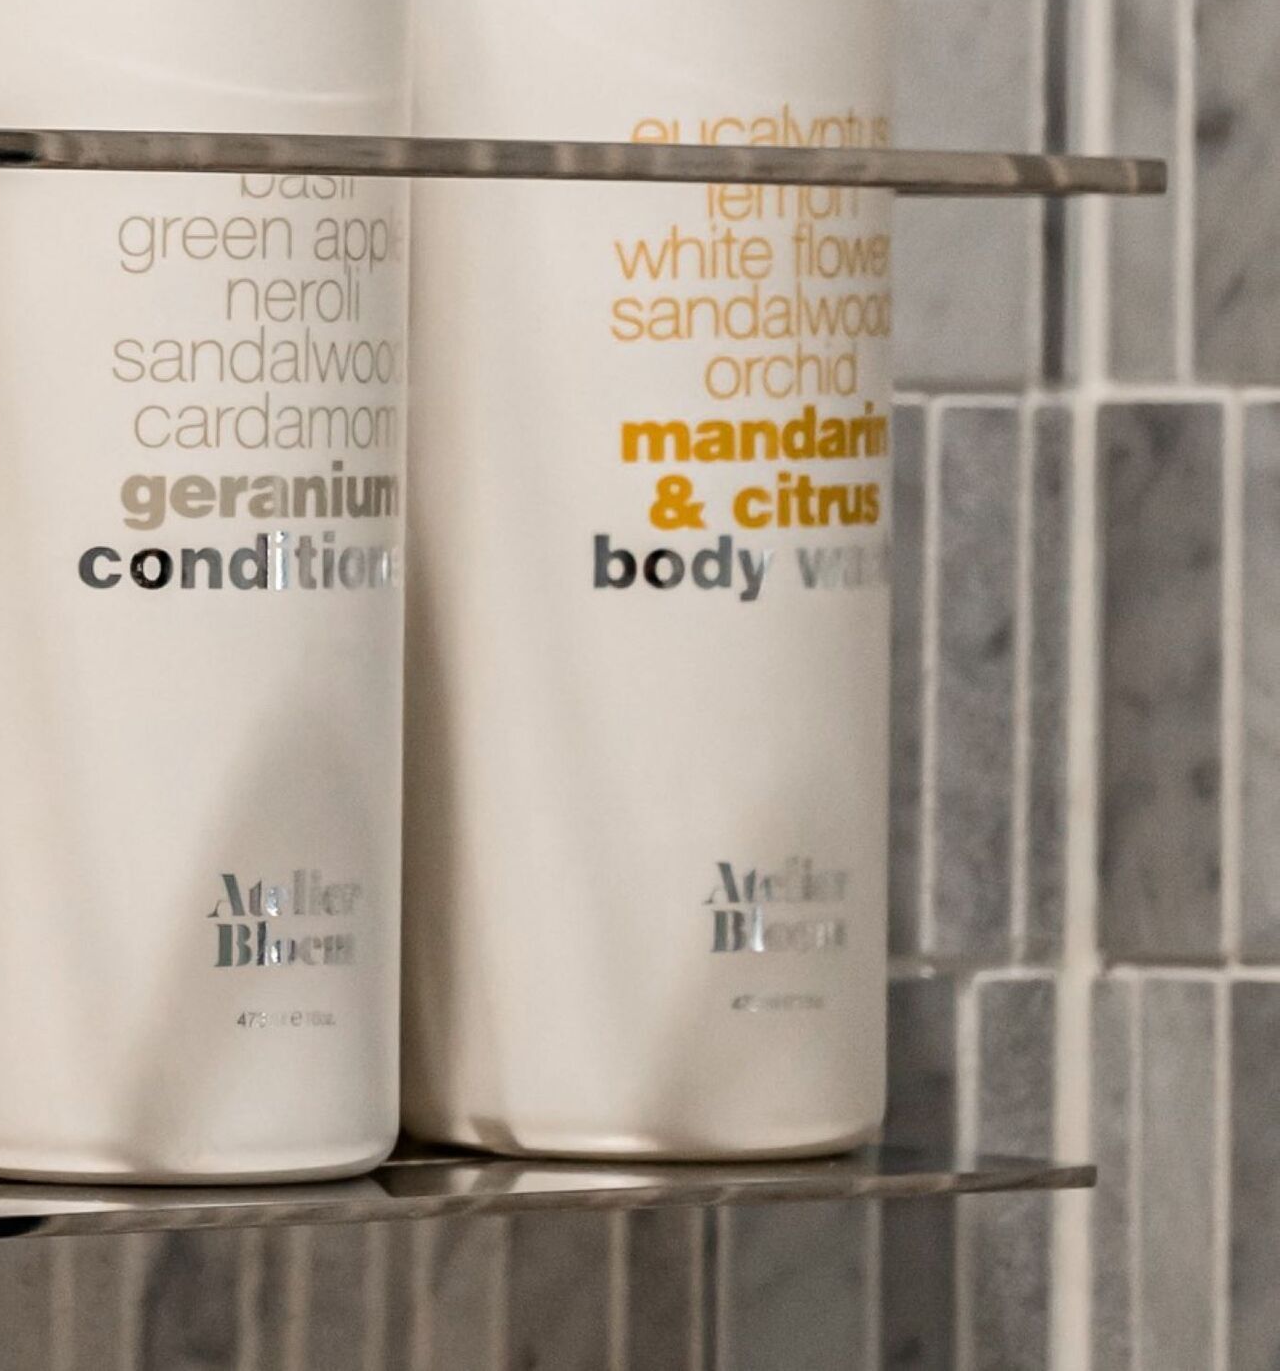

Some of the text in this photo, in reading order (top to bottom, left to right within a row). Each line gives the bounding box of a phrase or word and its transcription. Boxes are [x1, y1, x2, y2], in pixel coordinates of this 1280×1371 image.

[118, 215, 293, 273] green
[613, 224, 773, 280] white
[226, 265, 361, 323] neroli
[704, 342, 858, 400] orchid
[120, 460, 399, 532] geranium
[649, 471, 881, 531] & citrus
[593, 534, 775, 603] body
